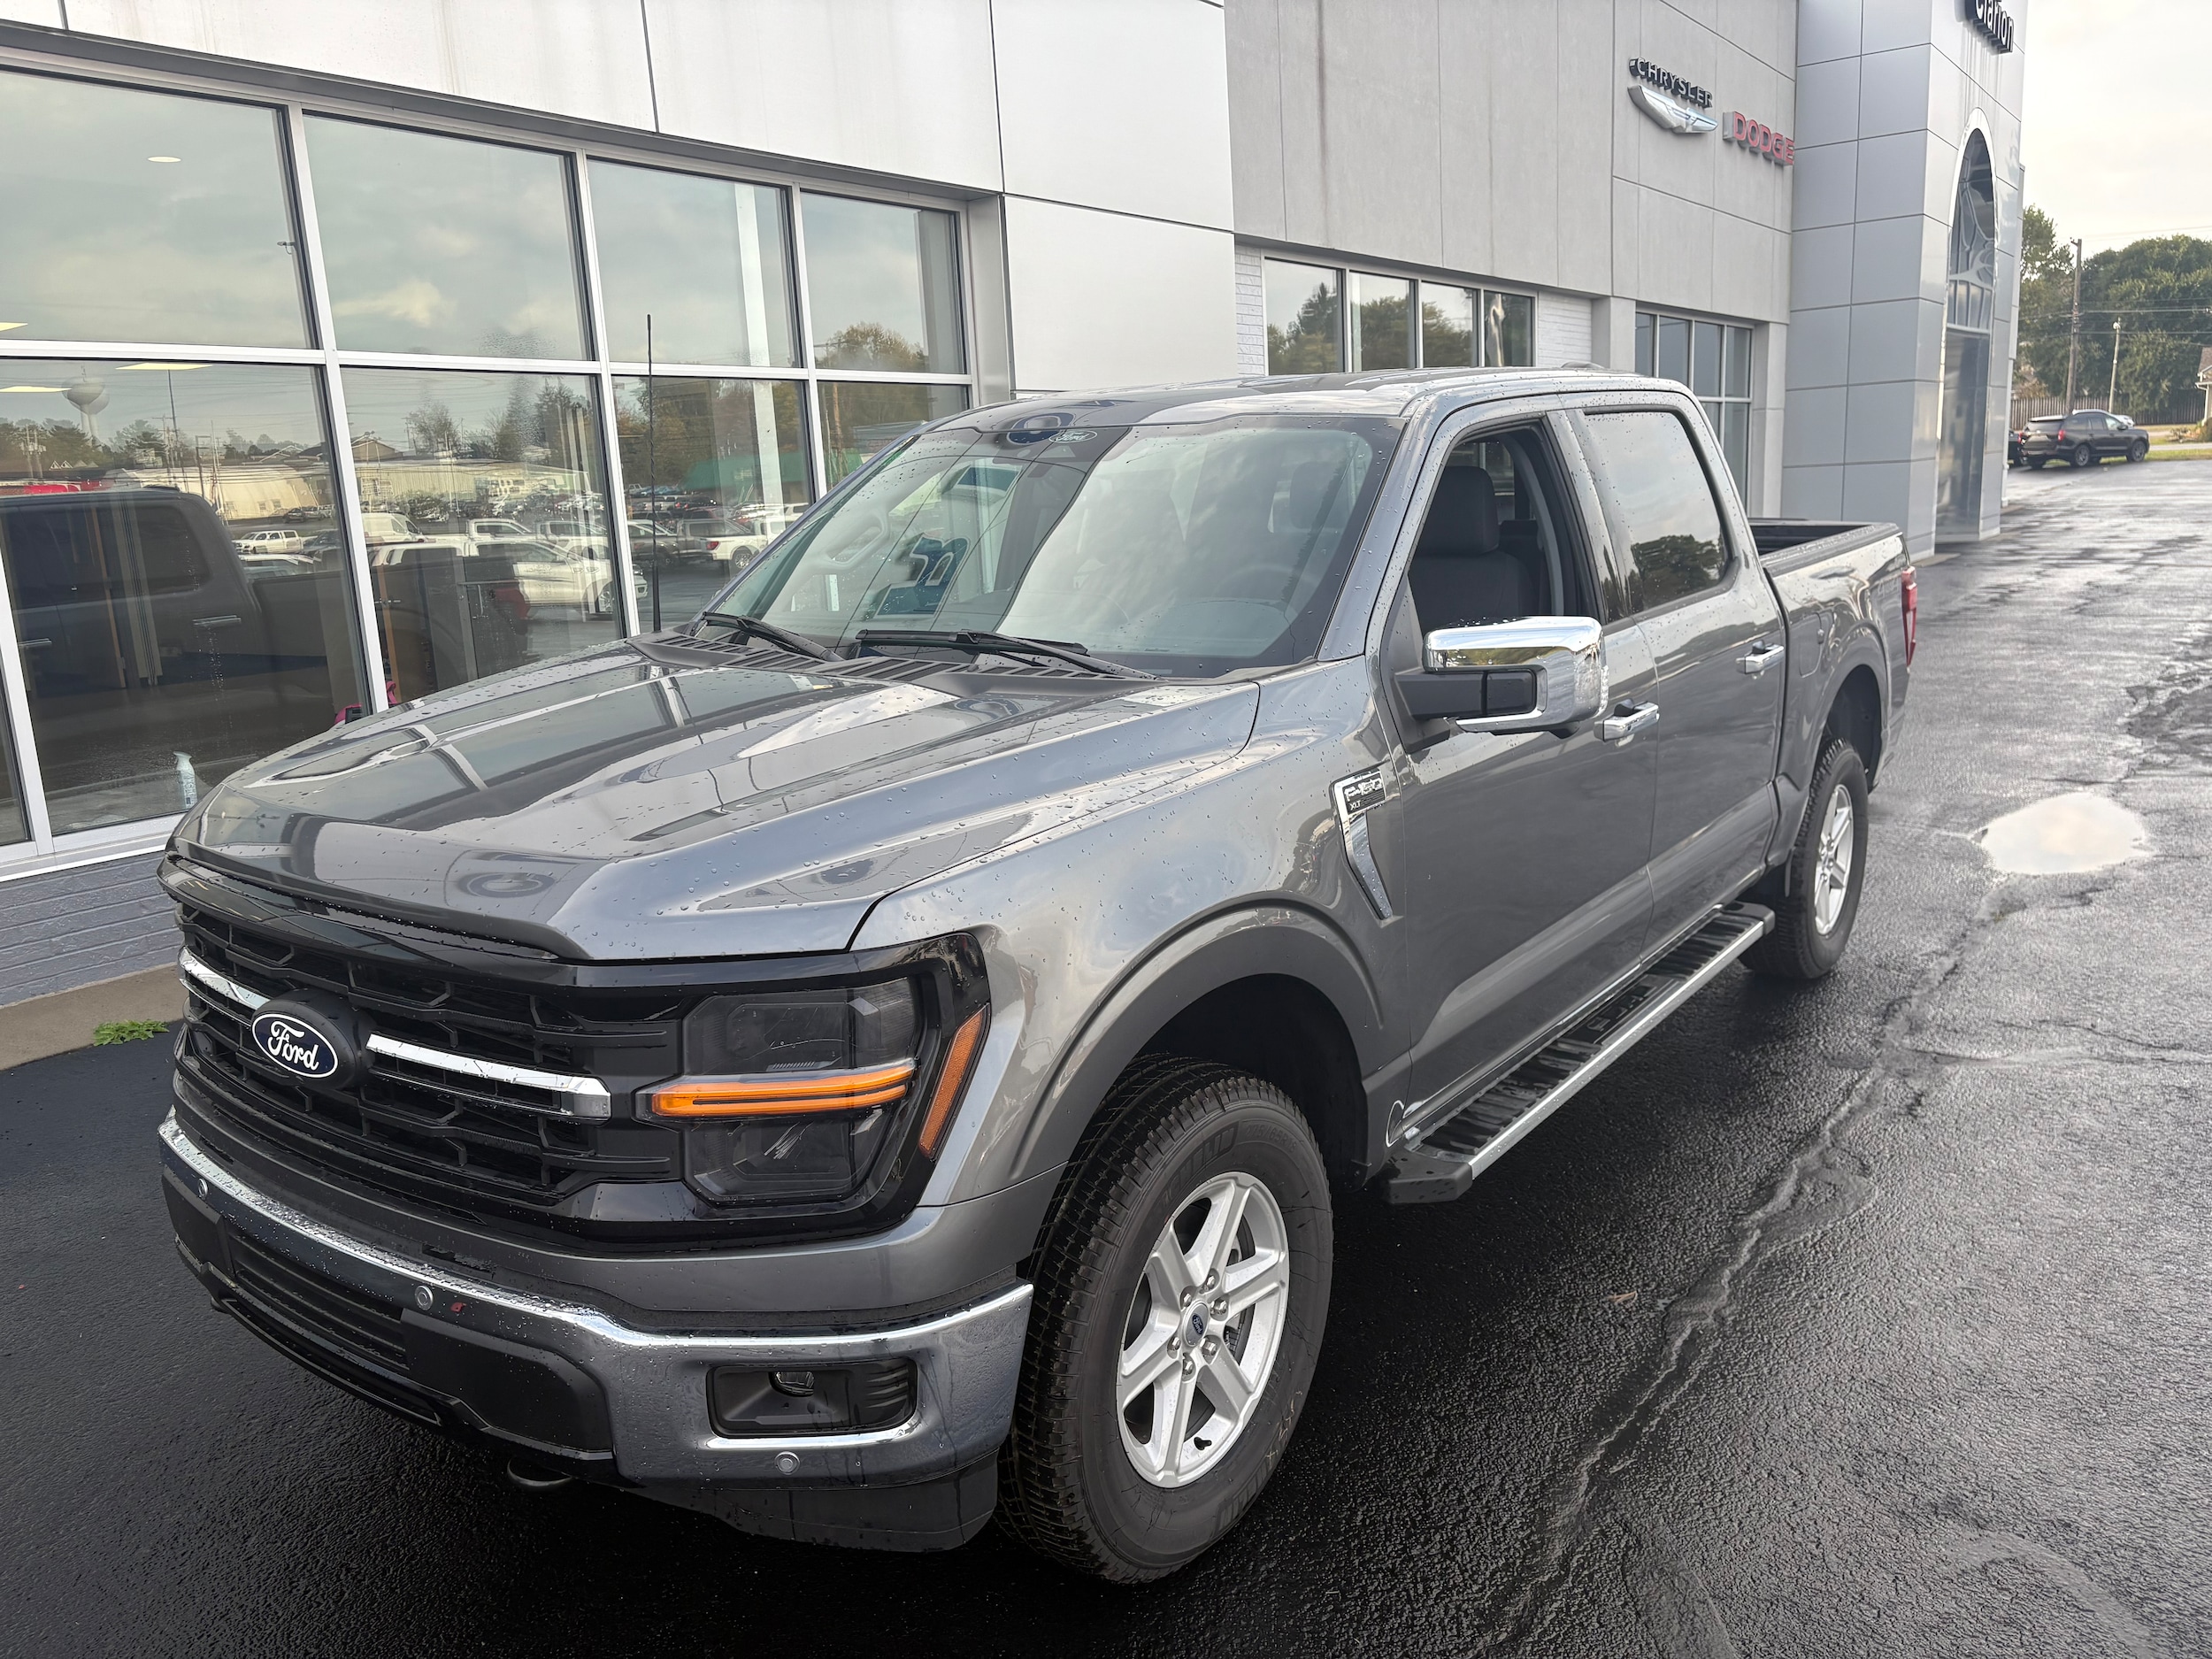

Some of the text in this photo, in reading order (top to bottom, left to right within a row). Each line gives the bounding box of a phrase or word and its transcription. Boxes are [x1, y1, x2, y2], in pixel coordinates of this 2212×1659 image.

[1636, 58, 1713, 108] CHRYSLER
[1733, 111, 1794, 165] DODGE
[1056, 431, 1089, 441] Ford
[1349, 800, 1362, 810] XLT
[267, 1020, 319, 1071] Ford
